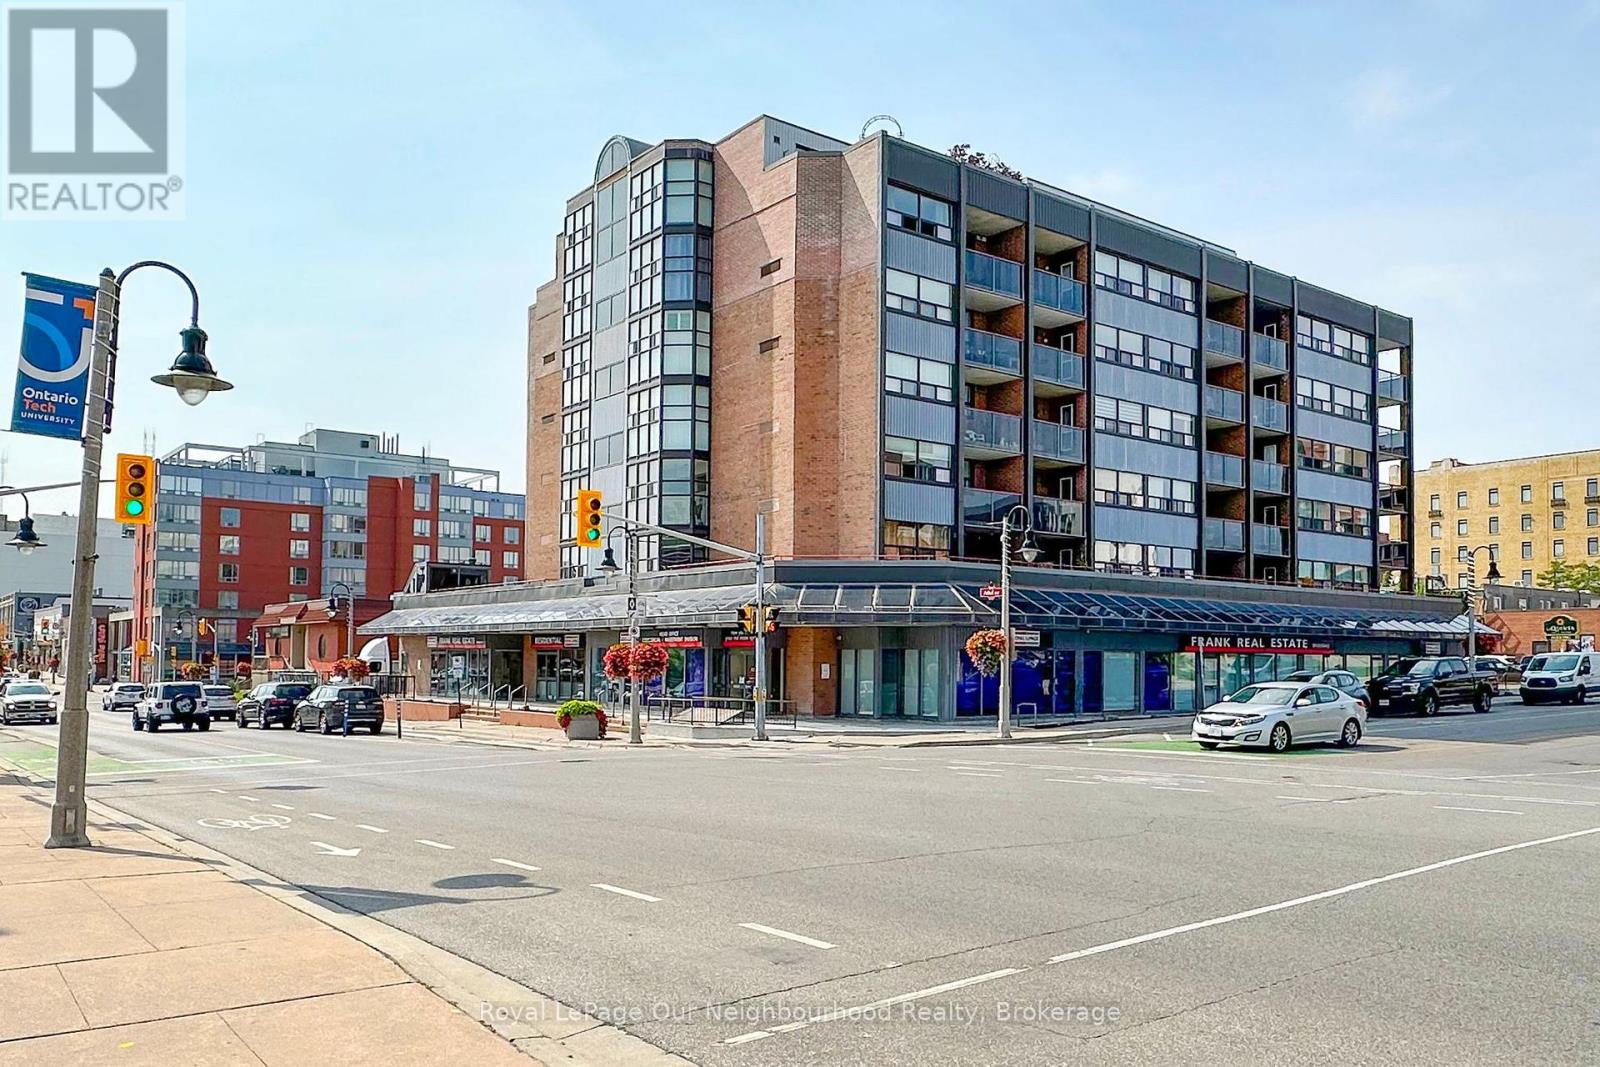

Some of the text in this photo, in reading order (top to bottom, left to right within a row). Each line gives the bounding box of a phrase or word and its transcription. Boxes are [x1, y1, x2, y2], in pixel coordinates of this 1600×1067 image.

[22, 387, 79, 406] Ontario
[24, 398, 56, 414] Tech
[20, 411, 76, 425] UNIVERSITY
[1191, 636, 1231, 648] FRANK
[1236, 637, 1265, 648] REAL
[1270, 638, 1308, 649] ESTATE
